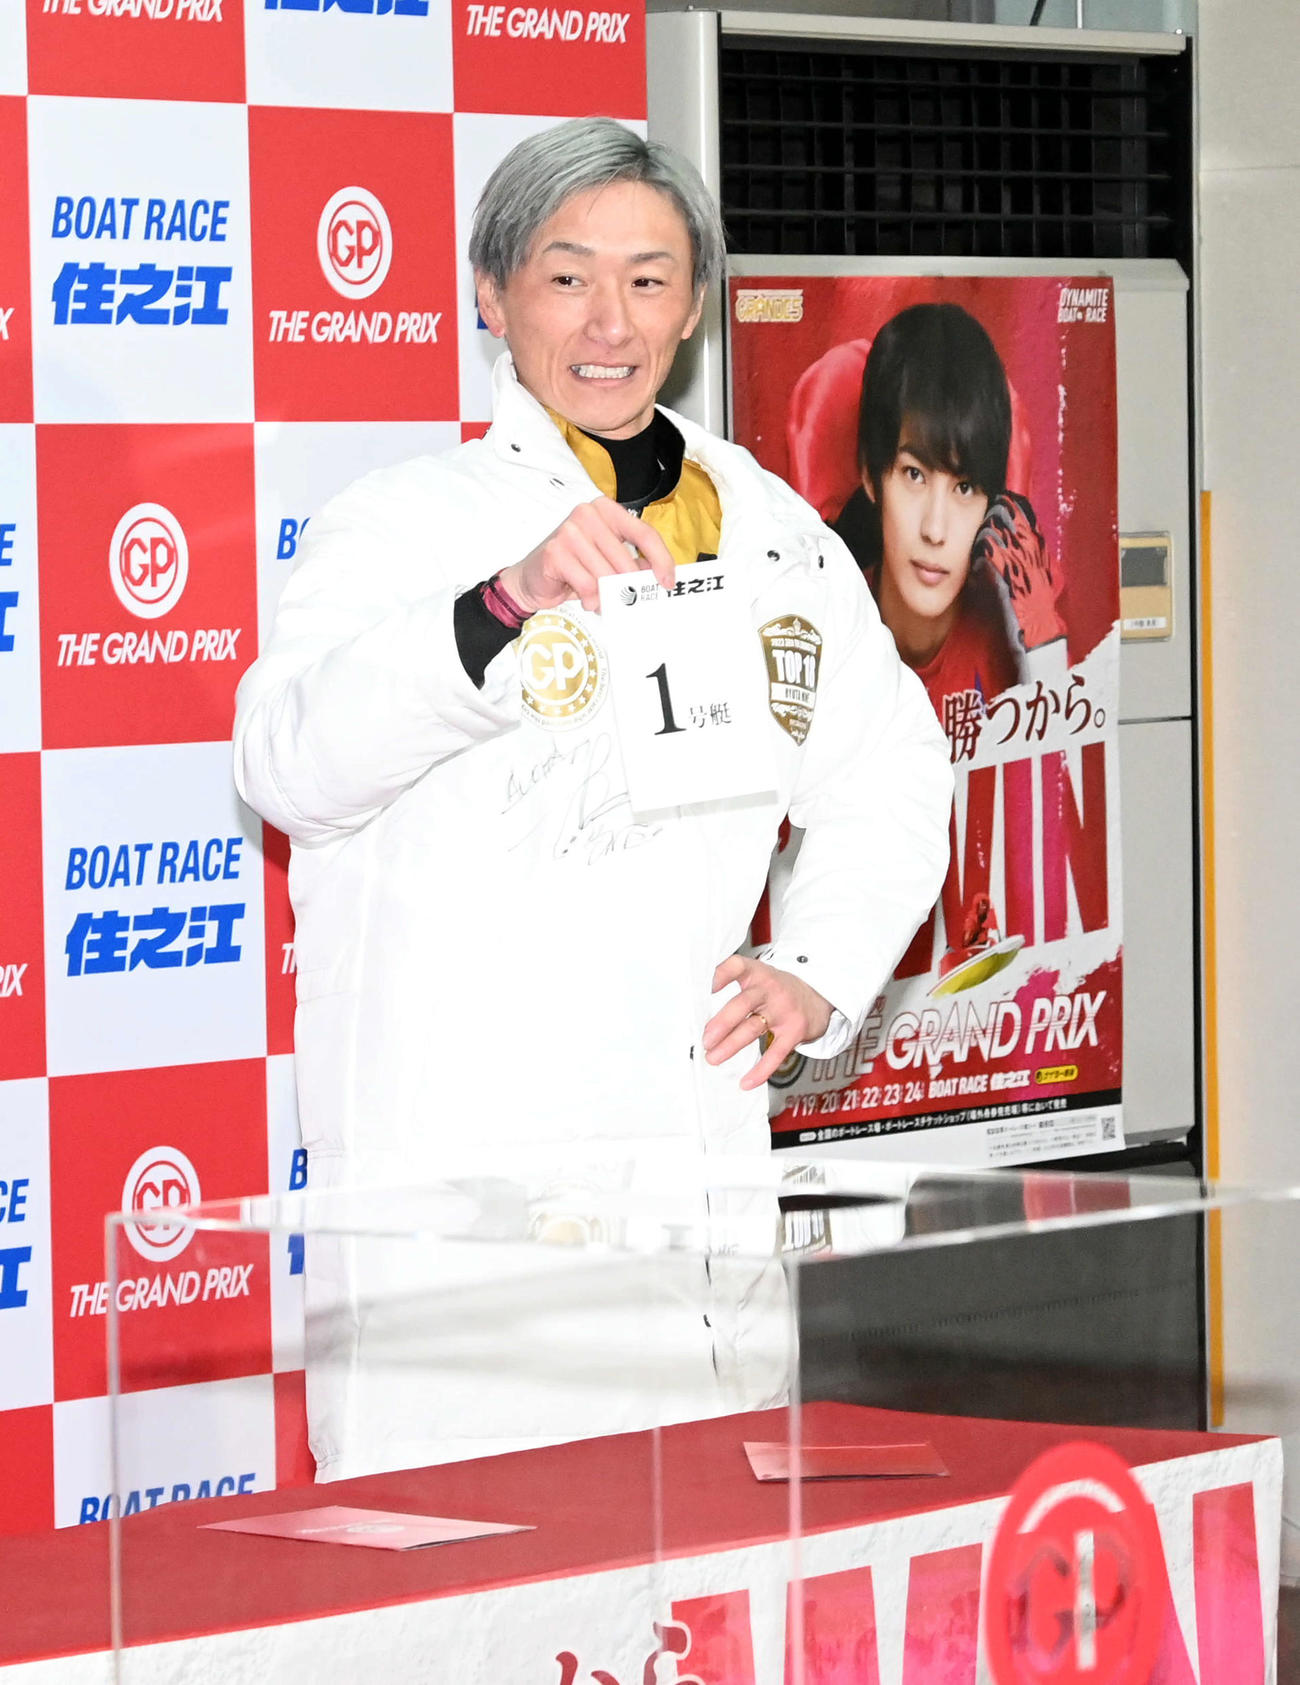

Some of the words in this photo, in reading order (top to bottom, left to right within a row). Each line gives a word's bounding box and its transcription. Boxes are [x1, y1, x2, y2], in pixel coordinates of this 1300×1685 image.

[466, 5, 503, 36] THE
[506, 7, 582, 42] GRAND
[584, 11, 630, 43] PRIX
[51, 196, 140, 240] BOAT
[143, 198, 230, 242] RACE
[330, 219, 380, 269] GP
[51, 262, 233, 326] 住之江
[1059, 287, 1109, 307] DYNAMITE
[268, 310, 309, 343] THE
[310, 310, 393, 344] GRAND
[393, 312, 442, 344] PRIX
[123, 536, 175, 588] GP
[57, 632, 101, 667] THE
[102, 629, 189, 665] GRAND
[190, 628, 242, 662] PRIX
[520, 641, 584, 691] GP
[771, 649, 803, 685] TOP
[65, 842, 154, 891] BOAT
[157, 837, 243, 884] RACE
[65, 902, 246, 977] 住之江
[885, 1000, 1023, 1070] GRAND
[1024, 990, 1108, 1055] PRIX
[928, 1076, 959, 1100] BOAT
[958, 1073, 988, 1096] RACE
[69, 1282, 112, 1318] THE
[115, 1270, 201, 1312] GRAND
[202, 1264, 254, 1301] PRIX
